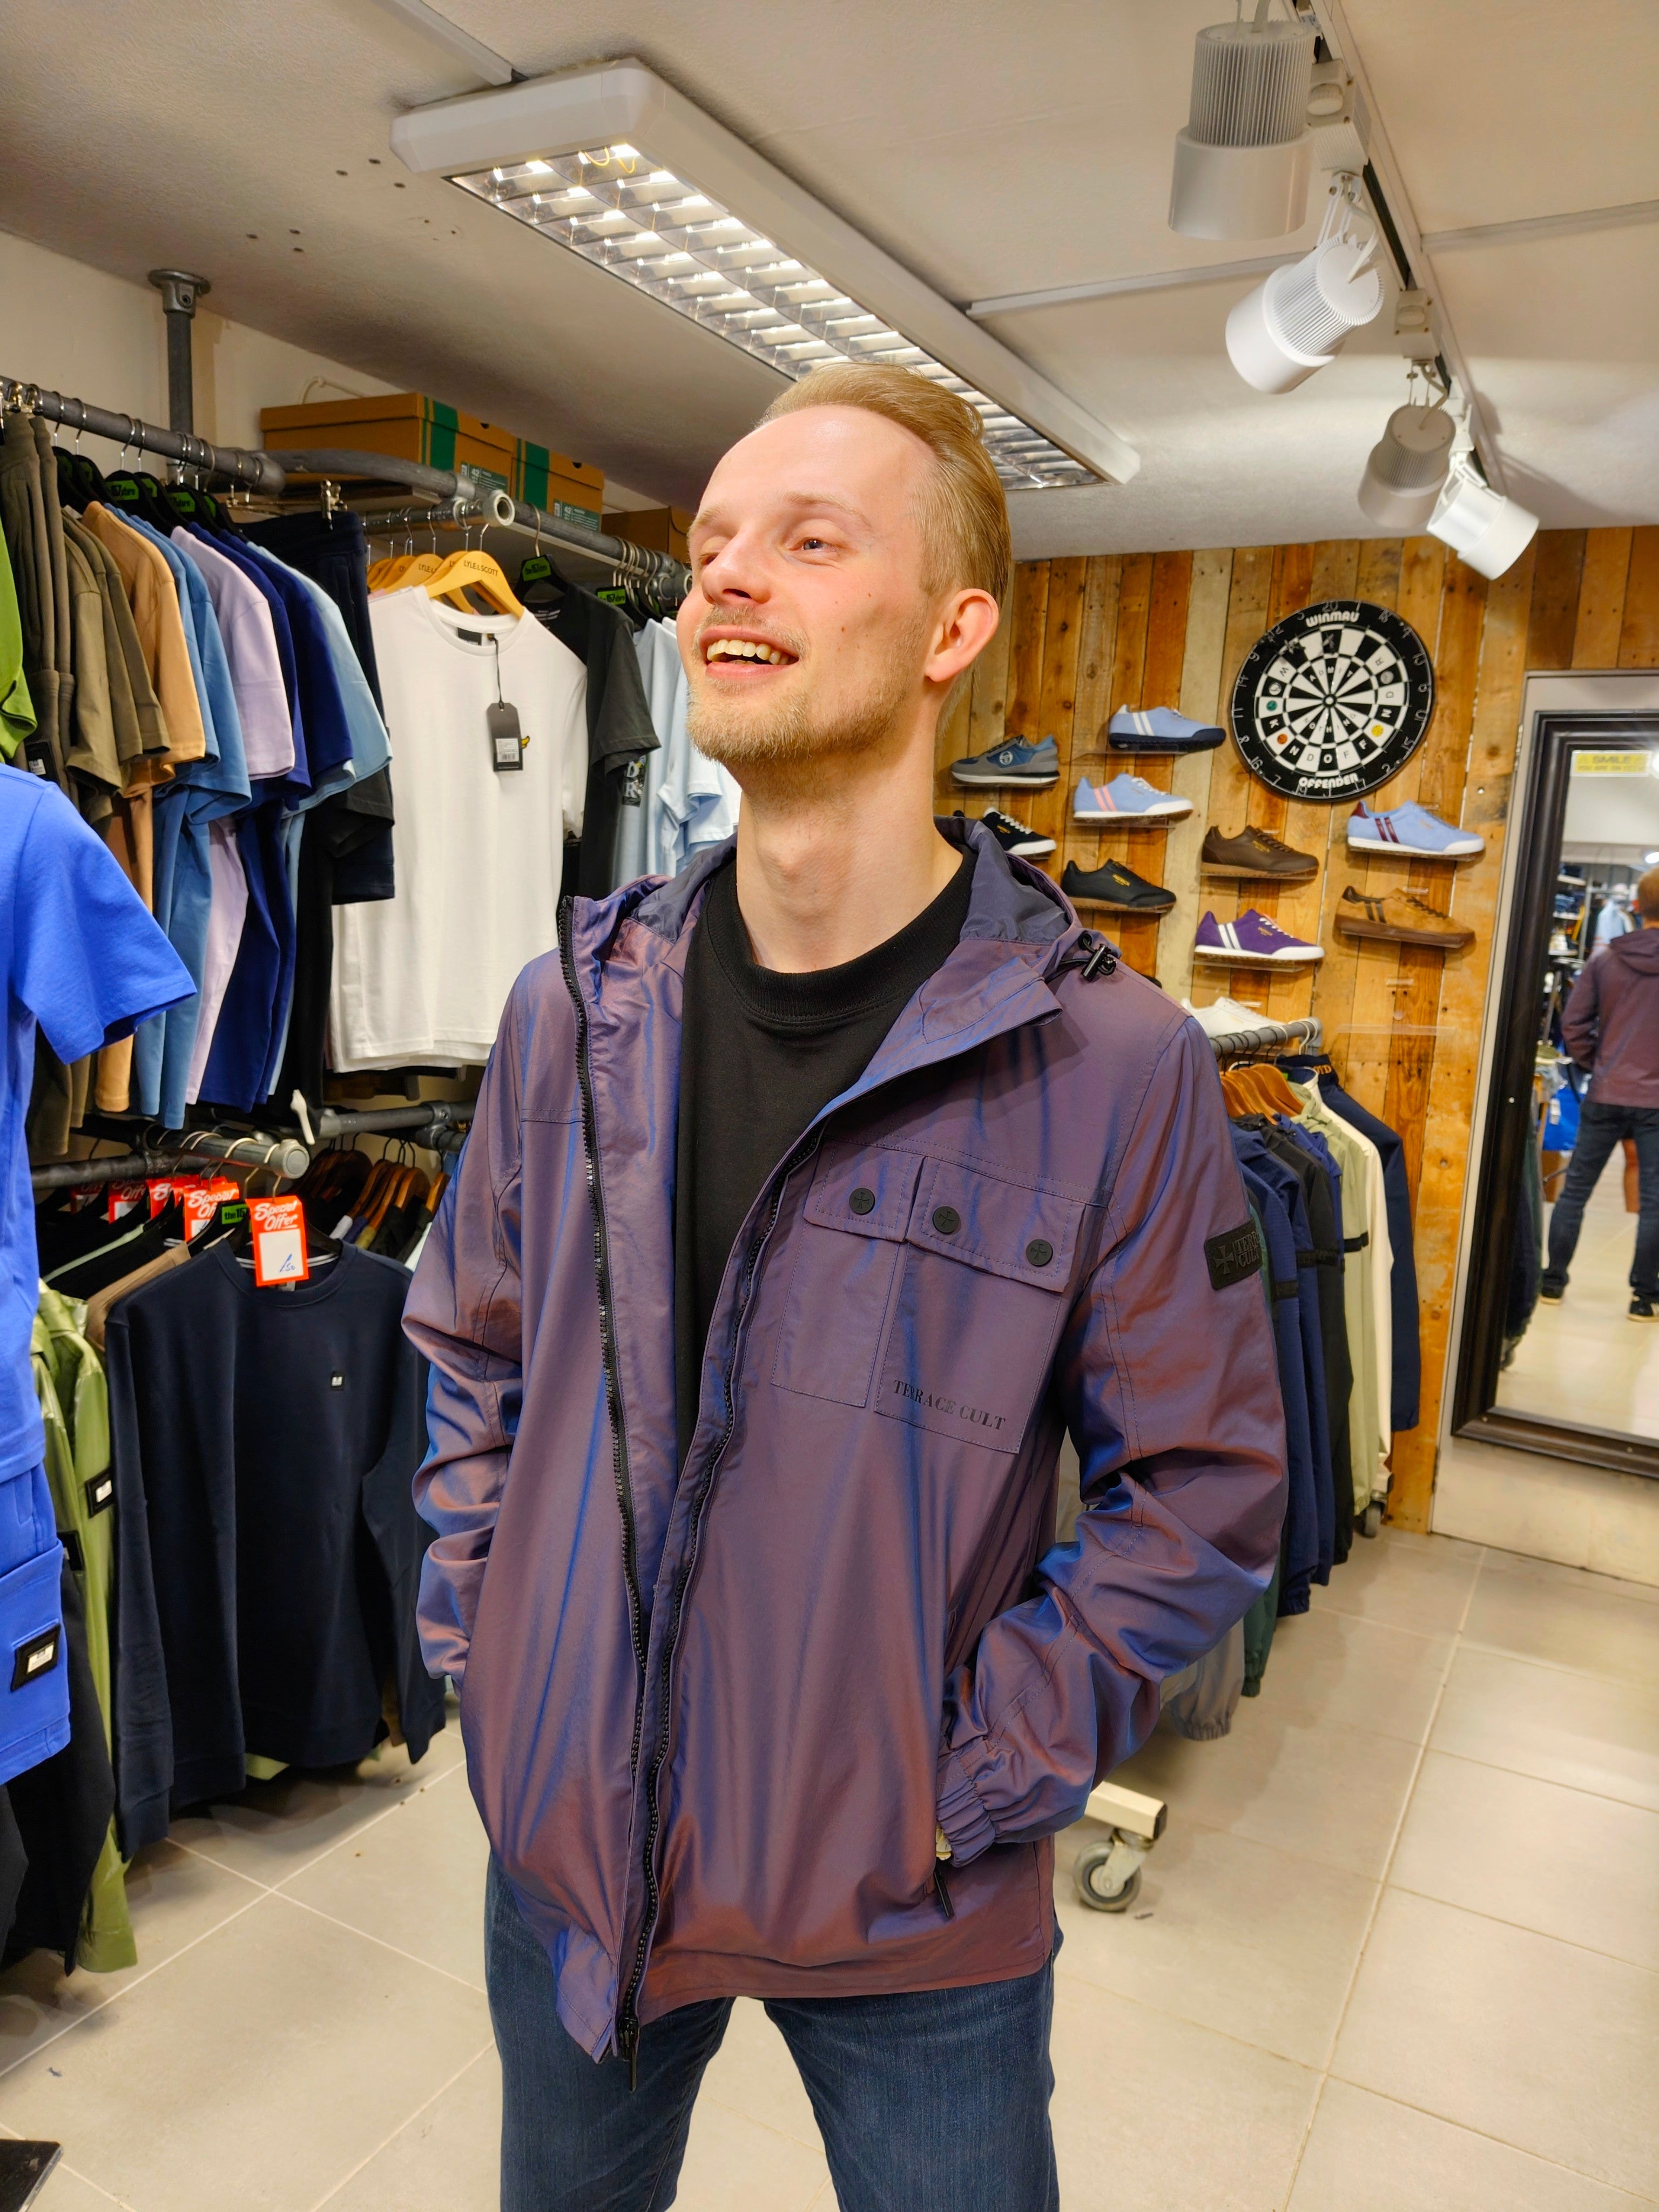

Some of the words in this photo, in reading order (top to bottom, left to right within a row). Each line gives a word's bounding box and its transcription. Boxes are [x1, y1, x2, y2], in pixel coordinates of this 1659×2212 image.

[464, 560, 476, 570] LYLE
[481, 565, 498, 576] SCOTT
[1299, 772, 1359, 789] OFFENDER
[187, 1189, 237, 1208] Special
[254, 1200, 298, 1221] Special
[264, 1213, 299, 1231] Offer
[894, 1379, 956, 1415] TERRACE
[959, 1405, 1006, 1431] CULT
